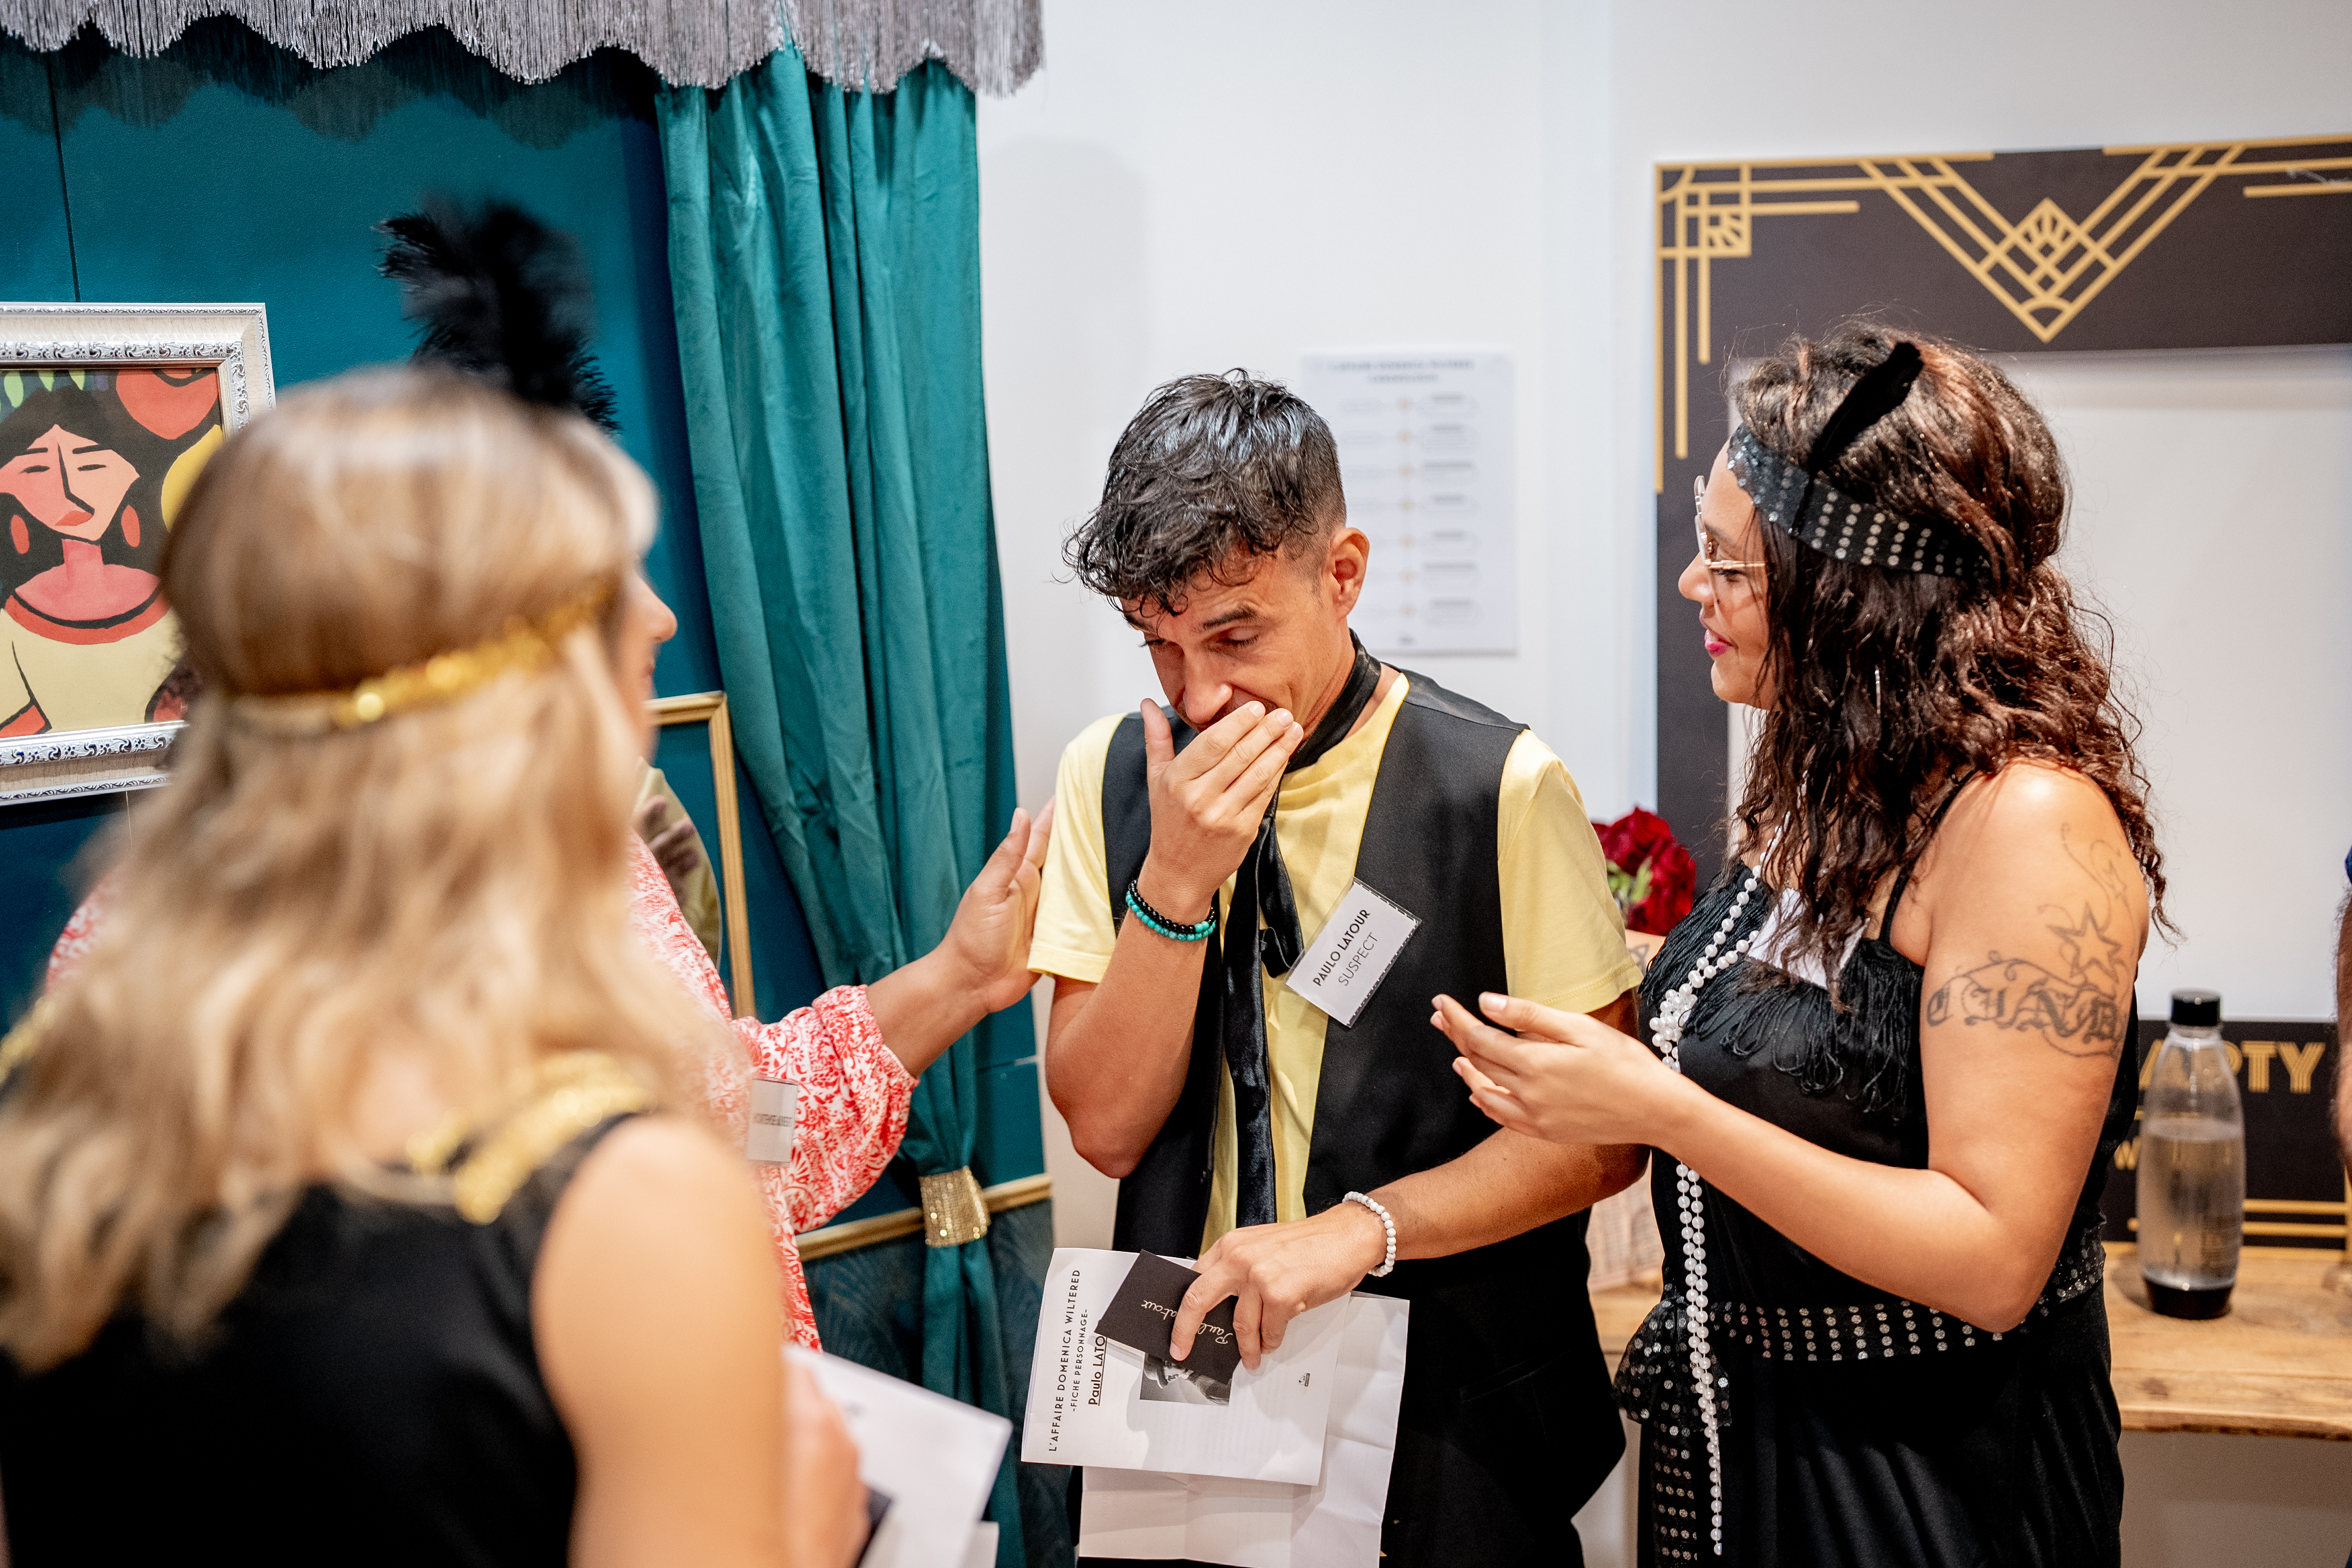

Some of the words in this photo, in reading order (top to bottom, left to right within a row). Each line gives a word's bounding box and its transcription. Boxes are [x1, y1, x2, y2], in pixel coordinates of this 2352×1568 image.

[1312, 951, 1341, 987] PAULO
[1337, 909, 1371, 950] LATOUR
[1338, 932, 1378, 987] SUSPECT
[1141, 1300, 1178, 1320] atour
[1197, 1322, 1233, 1344] Paul
[1048, 1396, 1064, 1452] L'AFFAIRE
[1057, 1329, 1072, 1391] DOMENICA
[1065, 1270, 1081, 1324] WILTERED
[1092, 1335, 1106, 1367] LATO
[1088, 1371, 1101, 1405] Paulo
